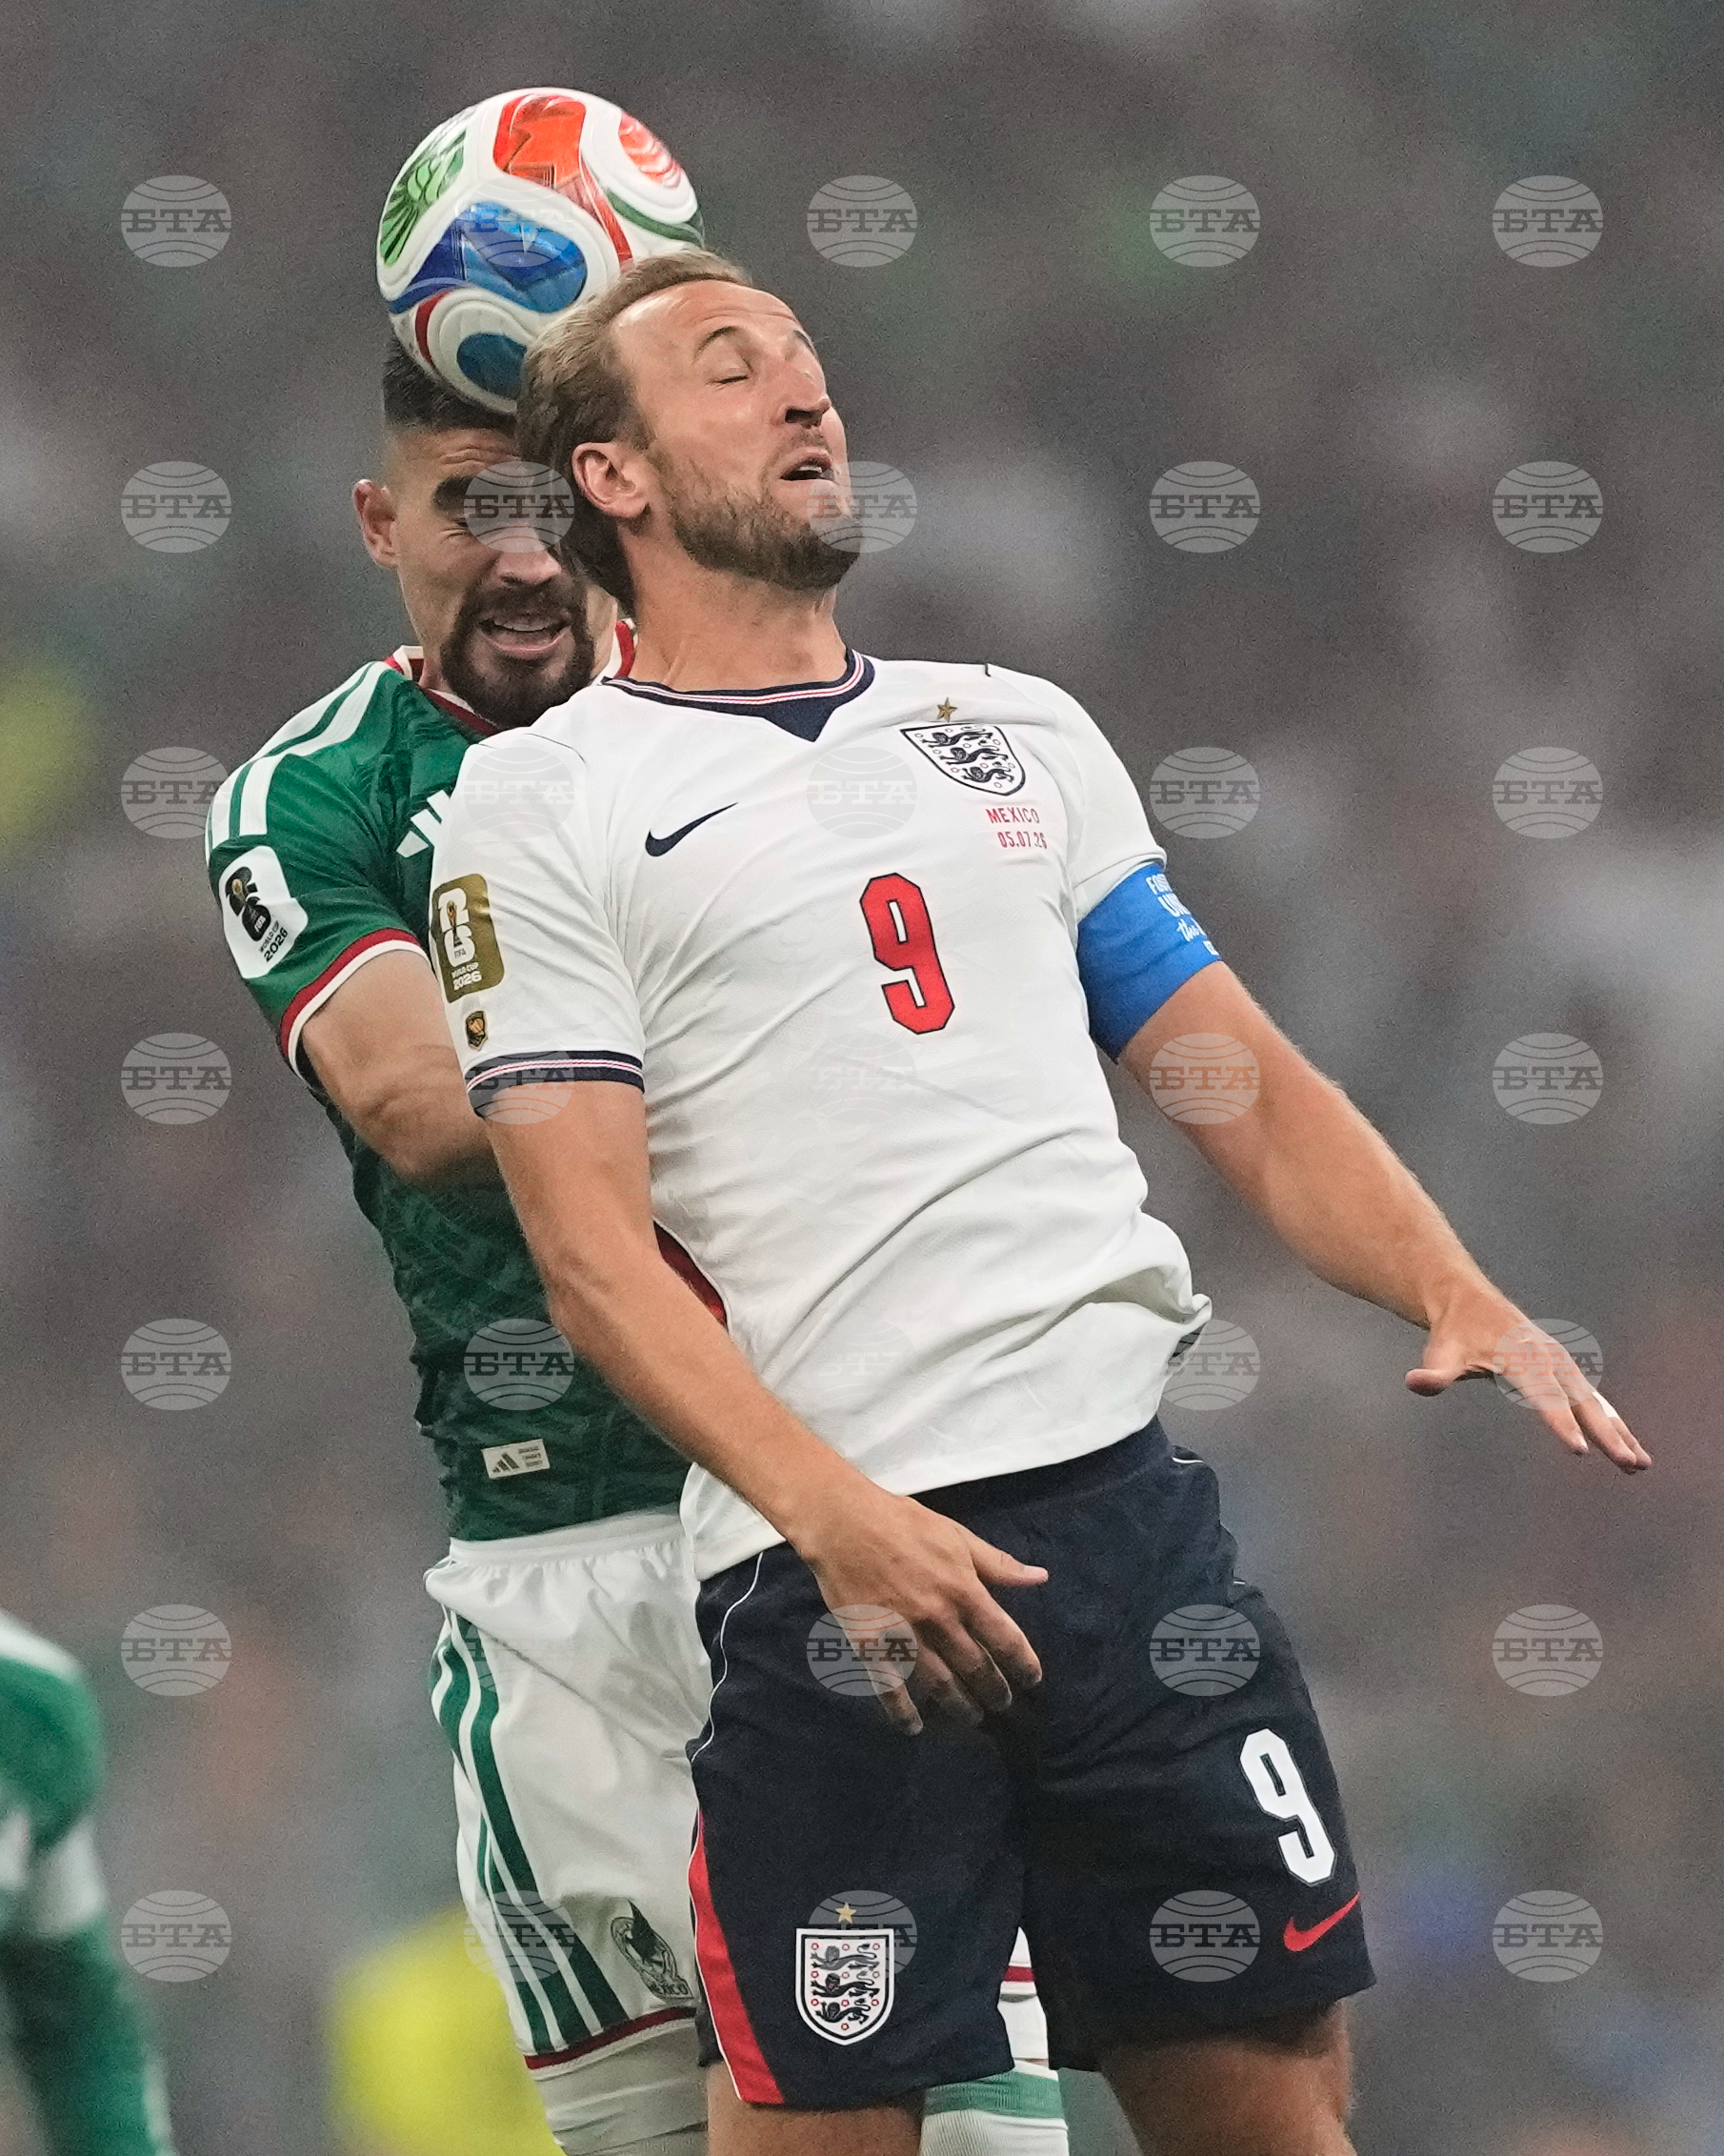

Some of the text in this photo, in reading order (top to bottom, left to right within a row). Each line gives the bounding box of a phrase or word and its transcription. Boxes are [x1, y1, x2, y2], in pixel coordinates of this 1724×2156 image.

[985, 806, 1040, 823] MEXICO
[997, 831, 1048, 849] 05.07.26
[264, 926, 289, 962] 2026
[859, 872, 955, 1035] 9
[453, 970, 482, 991] 2026
[1239, 1727, 1337, 1887] 9
